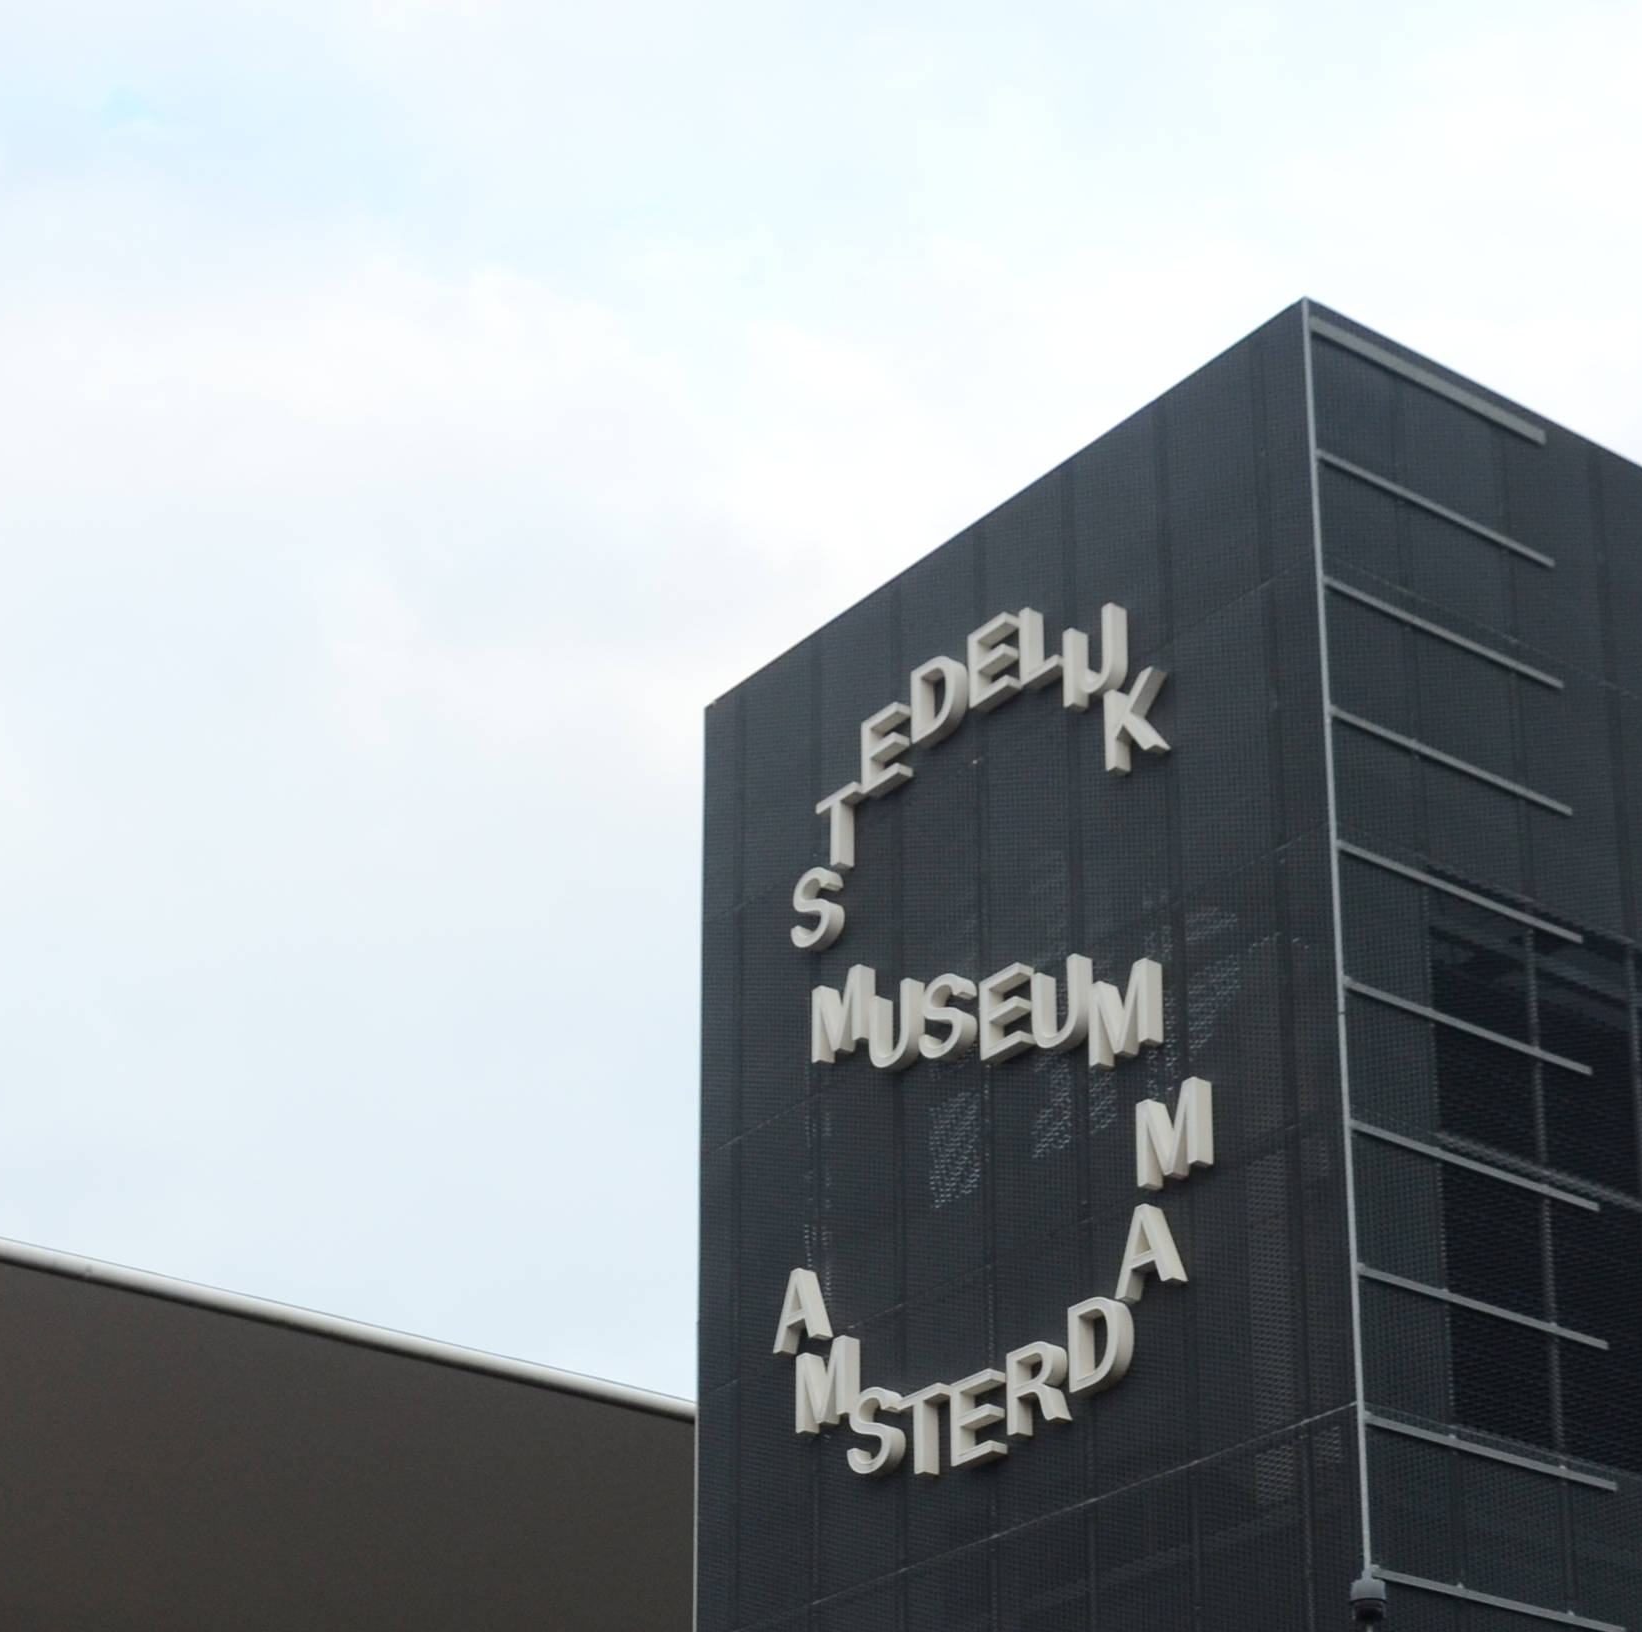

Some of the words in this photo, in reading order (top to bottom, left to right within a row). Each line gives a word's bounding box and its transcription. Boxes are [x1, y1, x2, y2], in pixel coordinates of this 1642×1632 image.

[791, 602, 1170, 950] STEDELIJK
[811, 953, 1164, 1069] MUSEUM
[772, 1077, 1214, 1477] AMSTERDAM
